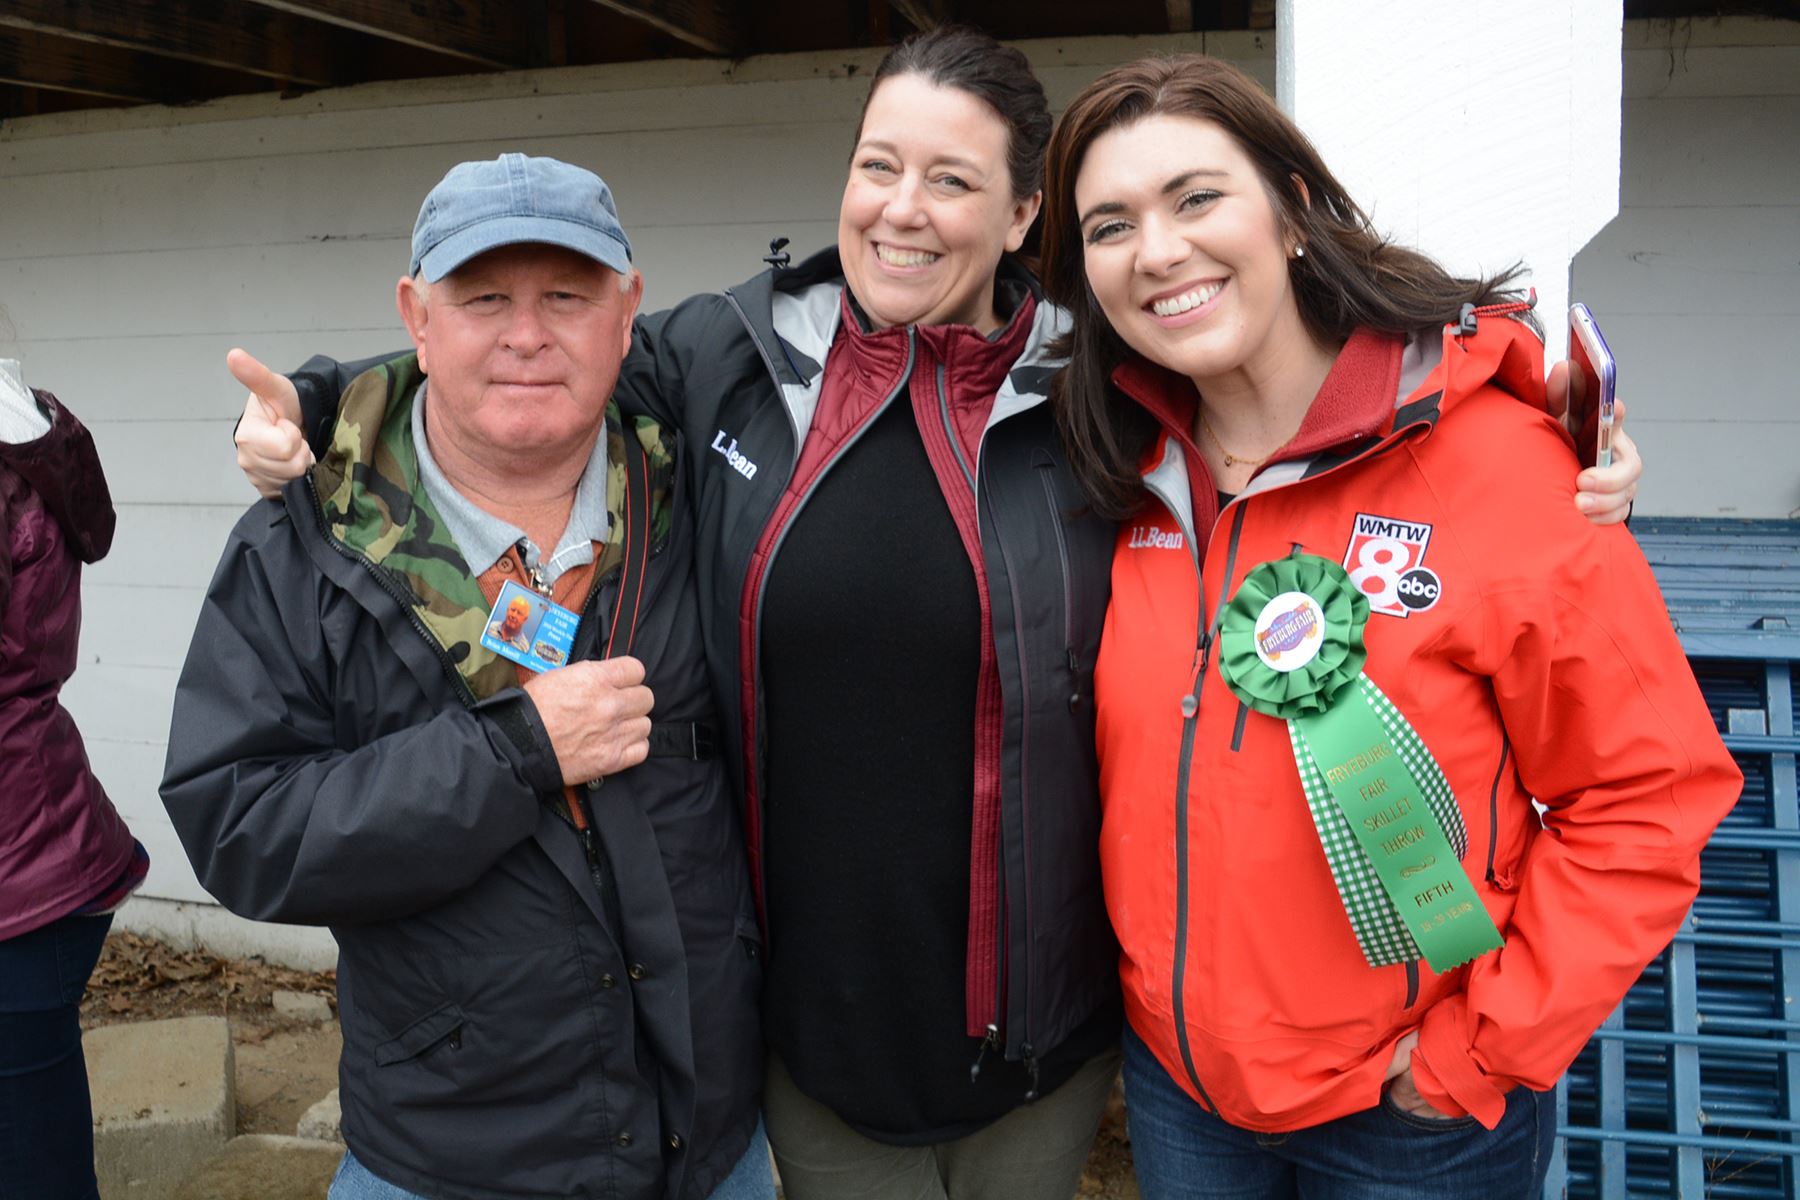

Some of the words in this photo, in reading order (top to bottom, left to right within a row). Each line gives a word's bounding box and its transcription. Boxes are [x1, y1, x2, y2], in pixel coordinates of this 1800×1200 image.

[1359, 517, 1426, 542] WMTW
[1348, 538, 1410, 608] 8
[1397, 576, 1438, 599] abc
[1326, 741, 1392, 786] FRYEBURG
[1359, 777, 1389, 802] FAIR
[1363, 797, 1413, 833] SKILLET
[1381, 824, 1425, 857] THROW
[1414, 880, 1454, 907] FIFTH
